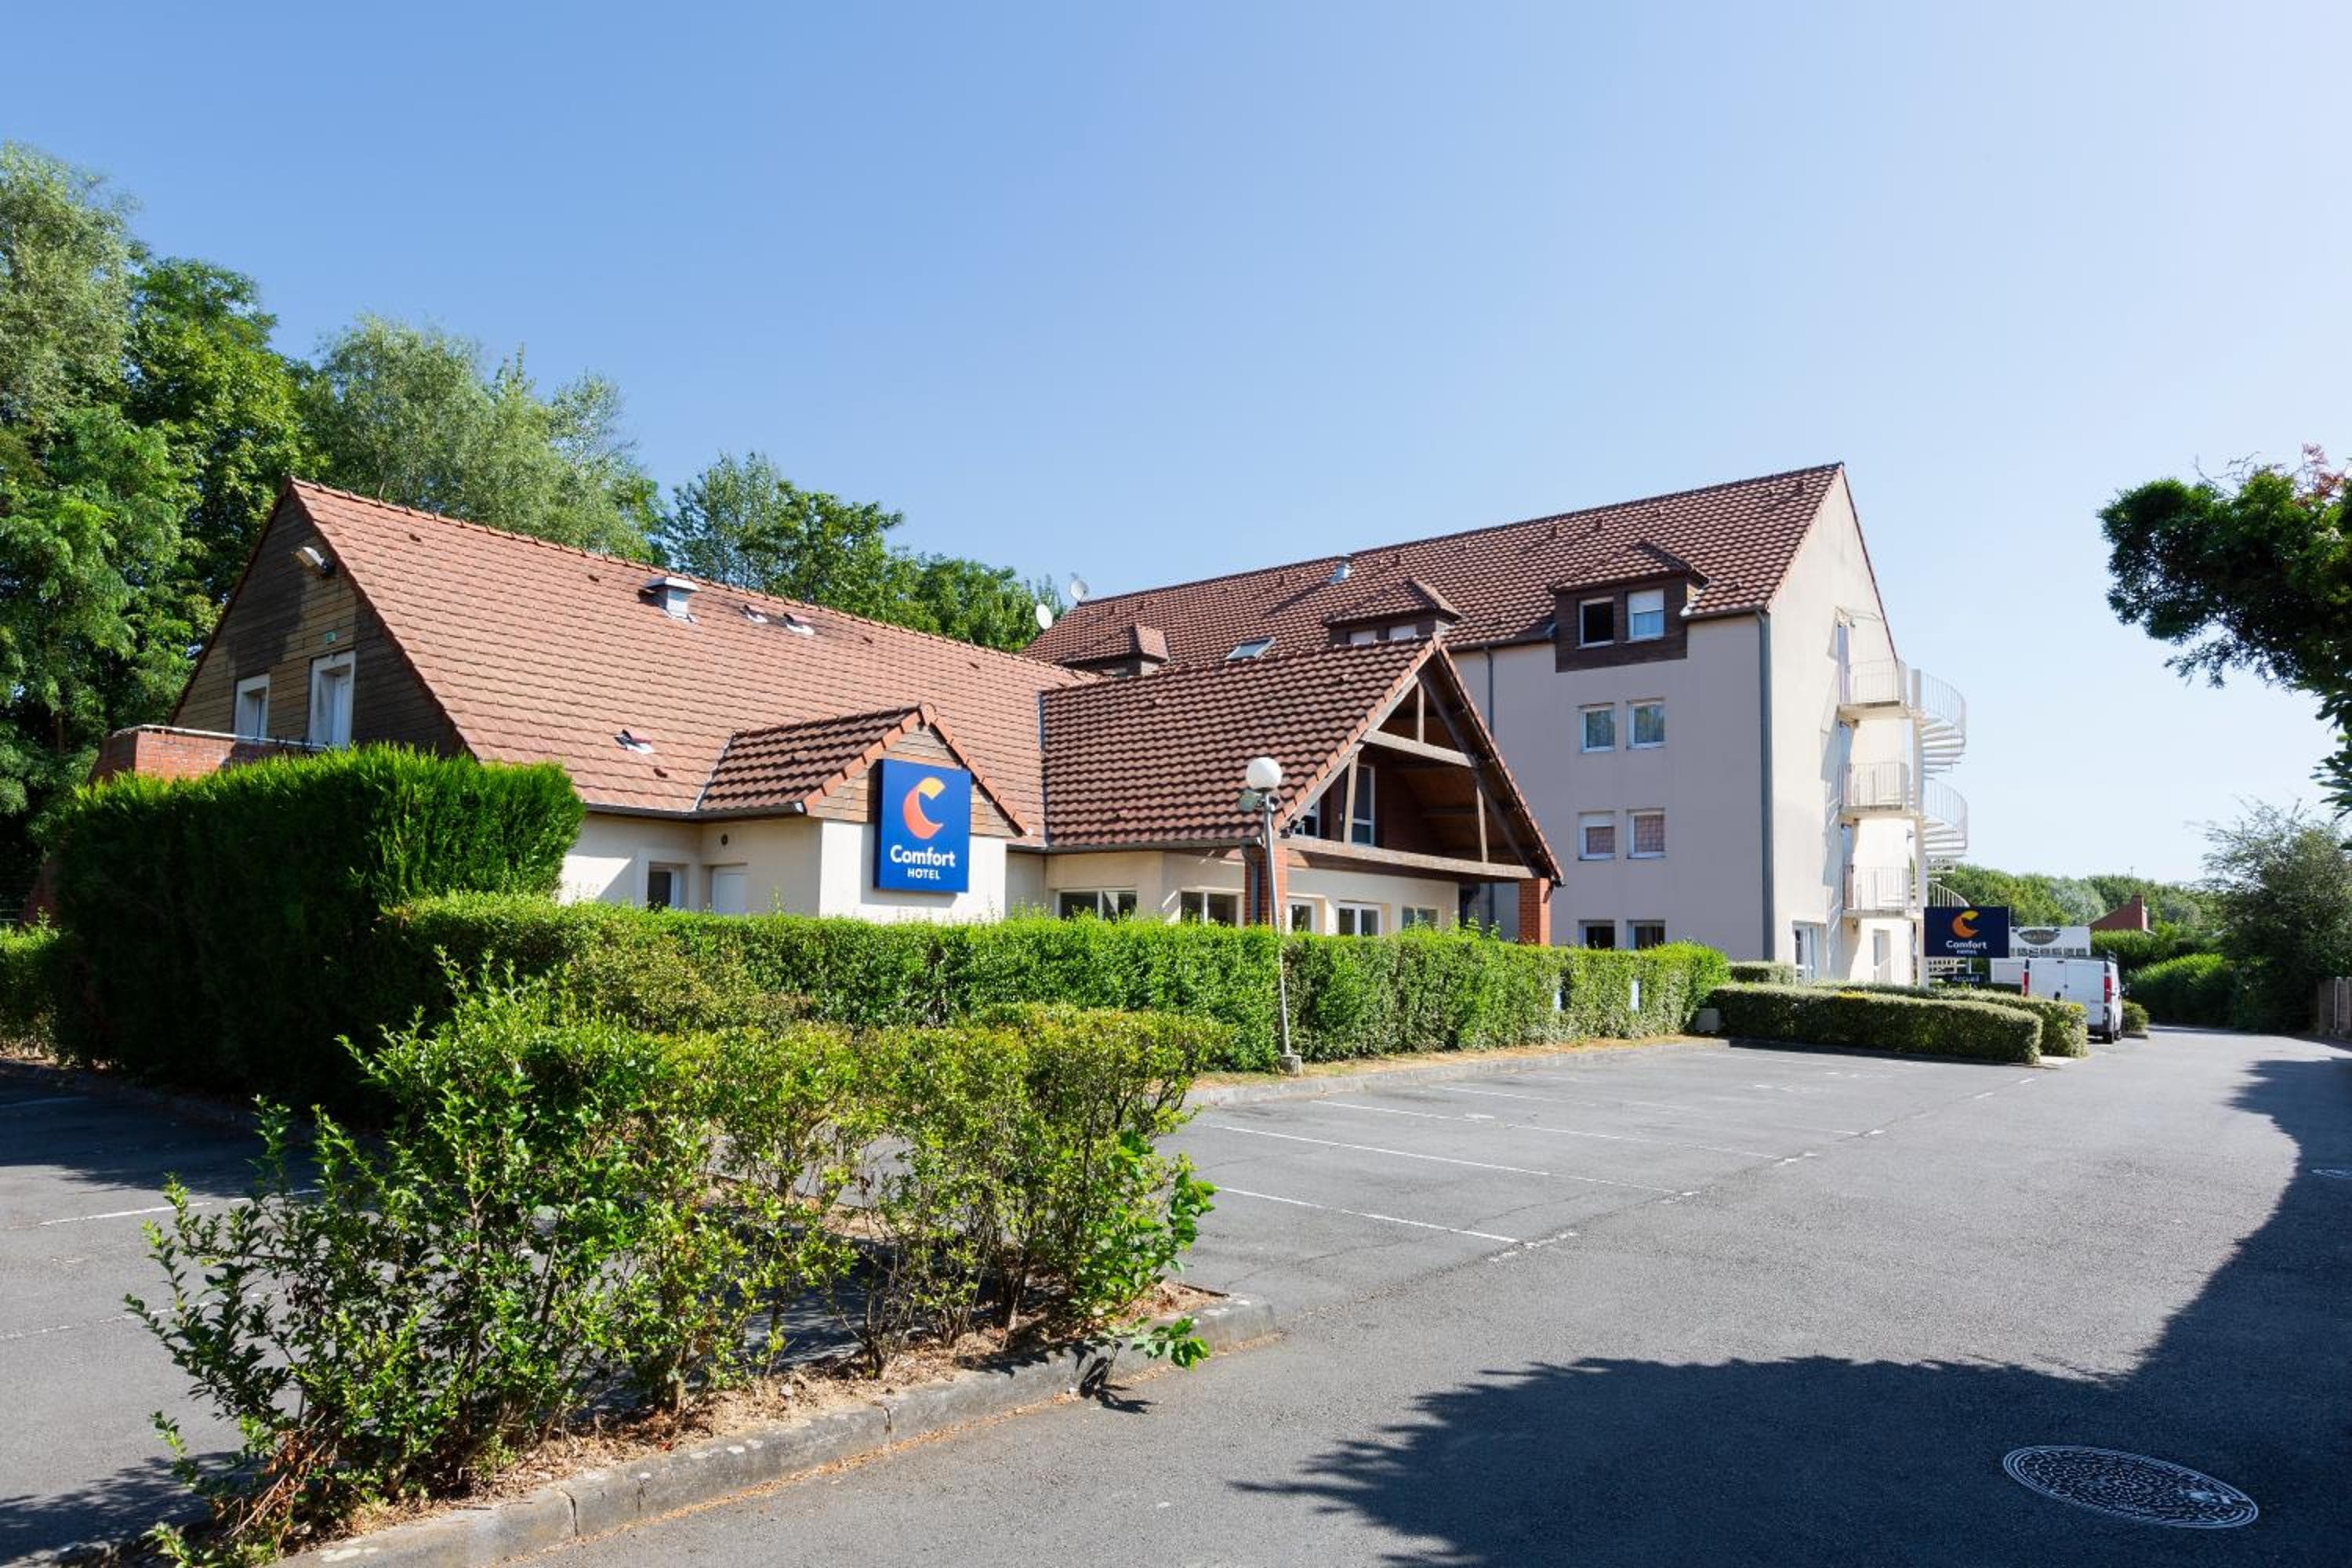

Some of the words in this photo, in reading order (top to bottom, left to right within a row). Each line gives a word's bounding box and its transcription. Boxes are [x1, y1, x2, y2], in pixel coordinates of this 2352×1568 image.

[890, 844, 956, 868] Comfort
[907, 868, 941, 880] HOTEL
[1945, 940, 1987, 949] Comfort
